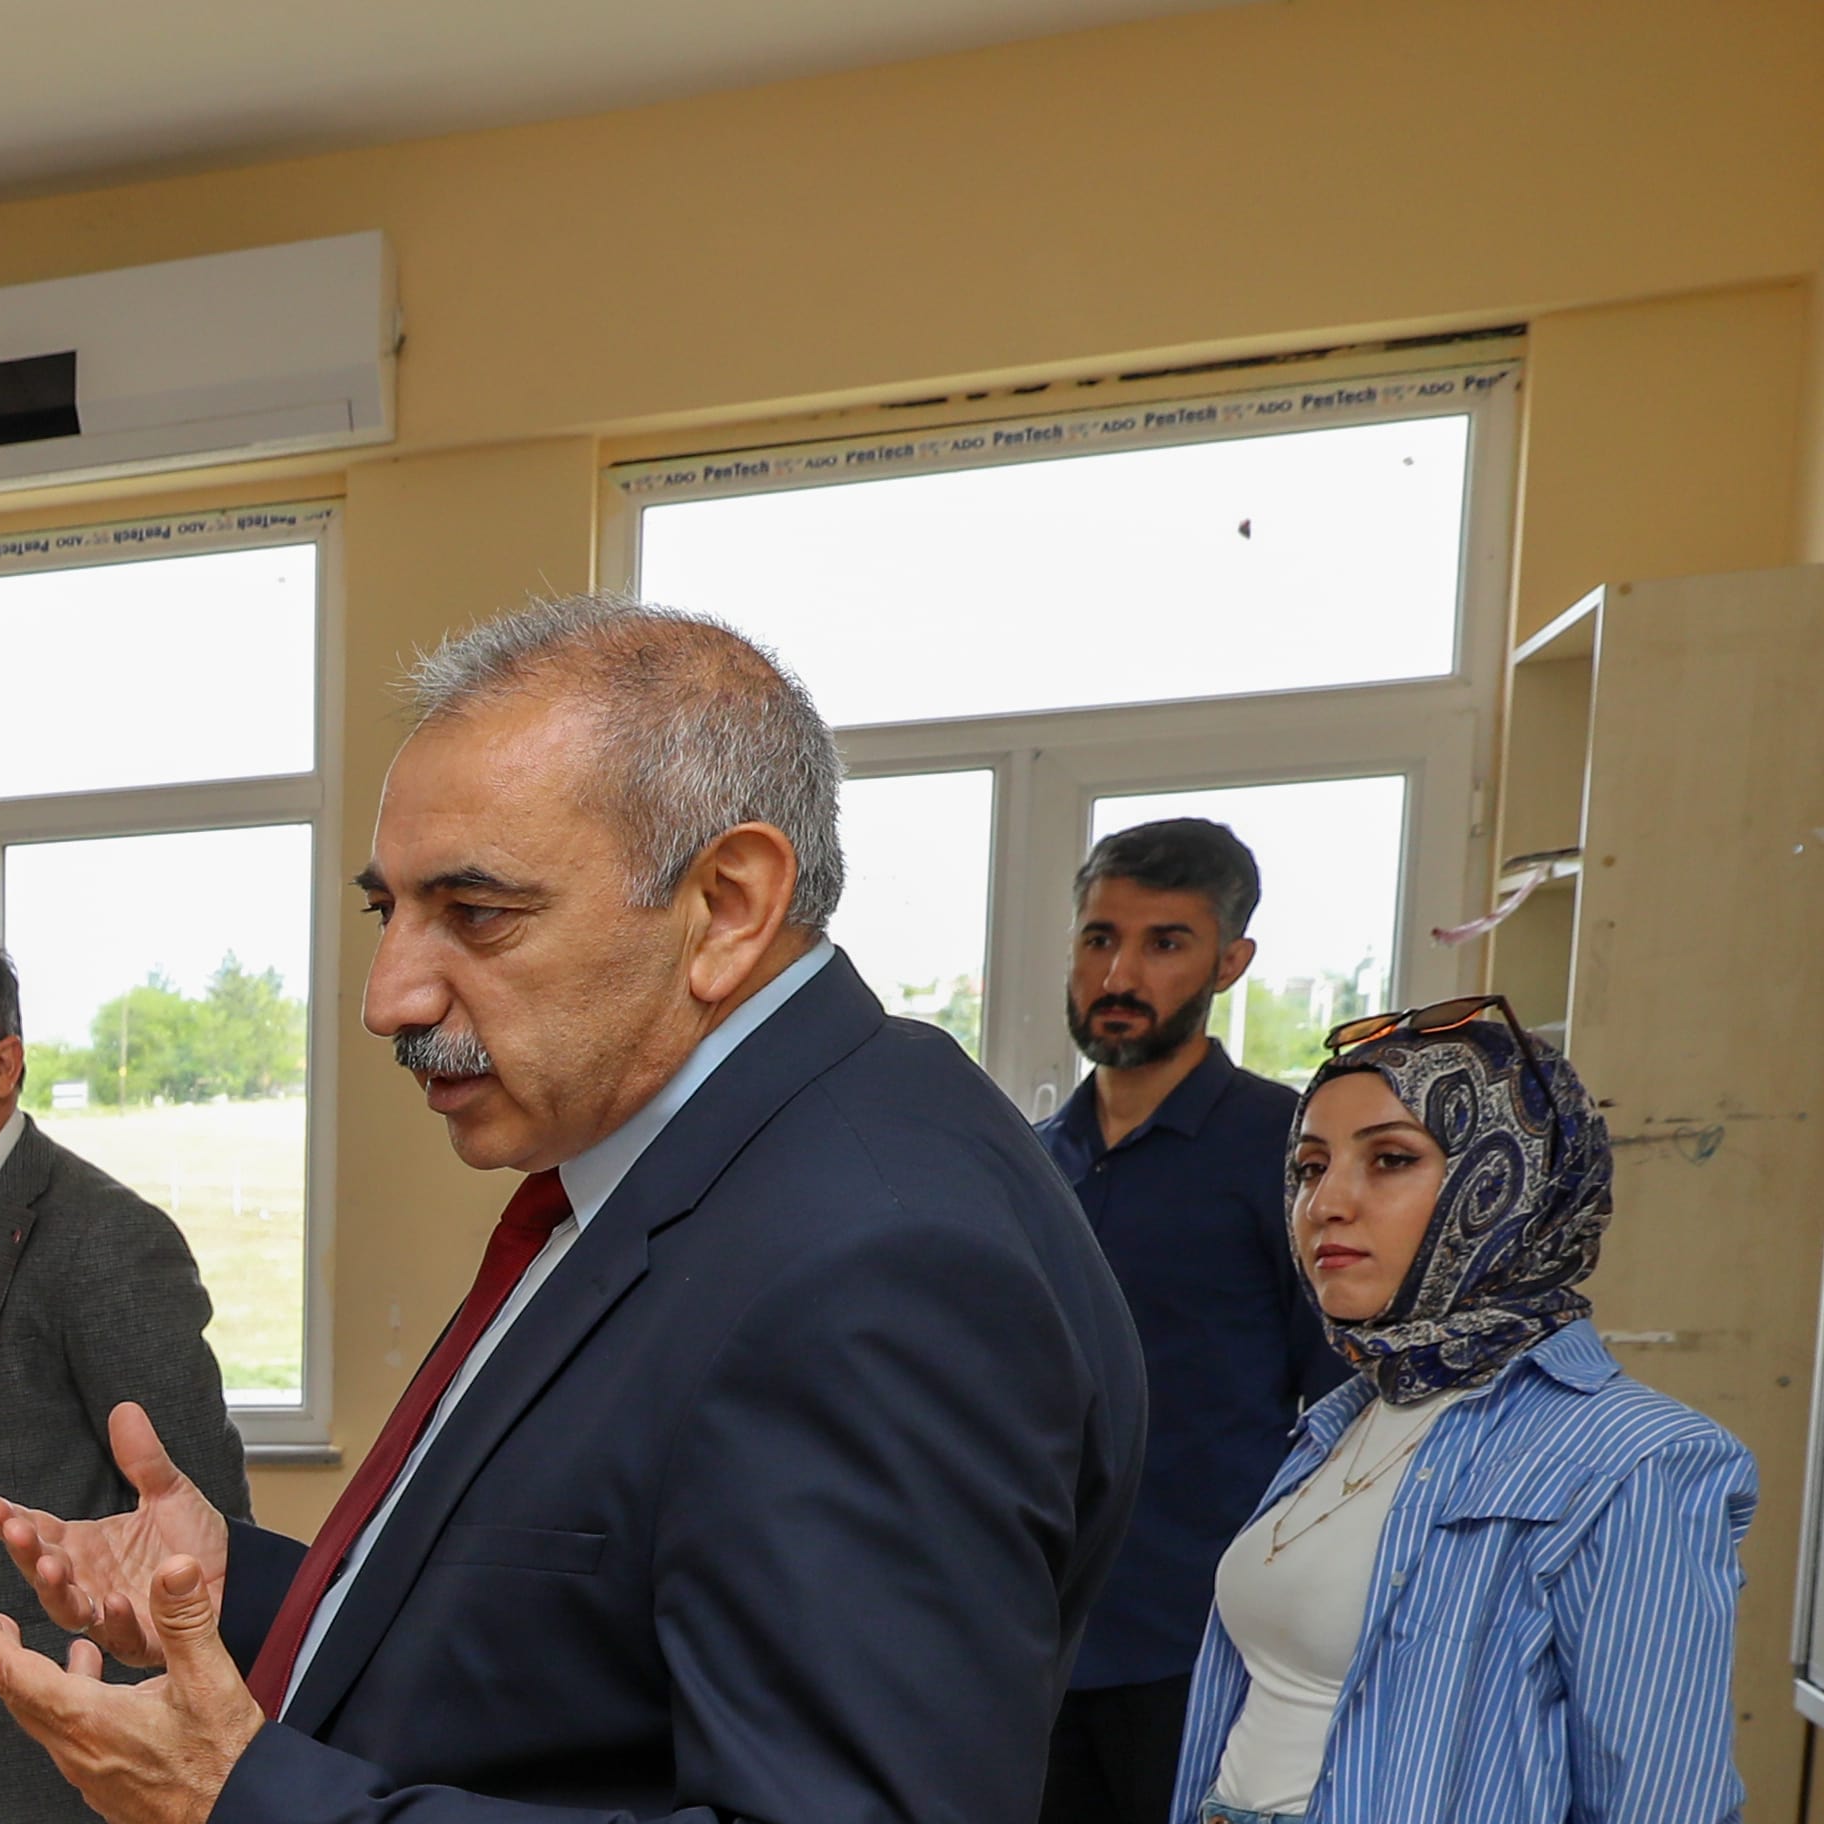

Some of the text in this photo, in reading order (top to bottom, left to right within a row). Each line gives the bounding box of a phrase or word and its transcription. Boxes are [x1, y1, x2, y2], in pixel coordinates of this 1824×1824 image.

[704, 462, 770, 481] PenTech
[993, 425, 1063, 446] PenTech
[1144, 406, 1218, 429] PenTech
